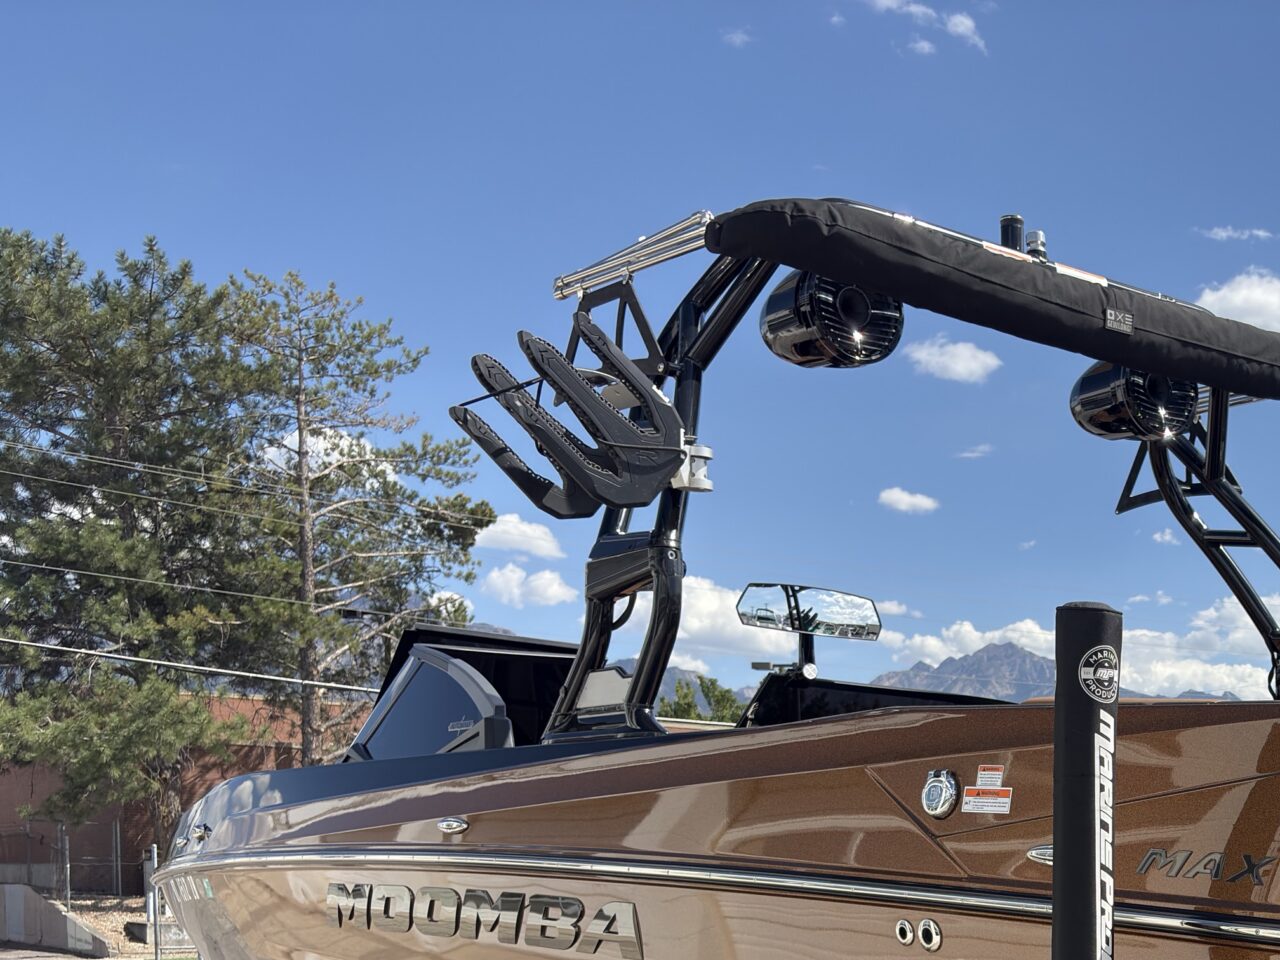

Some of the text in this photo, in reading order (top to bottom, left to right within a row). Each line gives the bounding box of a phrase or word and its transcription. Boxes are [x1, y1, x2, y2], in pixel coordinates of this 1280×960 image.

[1094, 708, 1115, 871] MARINE
[1135, 847, 1278, 887] MAX
[326, 882, 645, 960] MOOMBA
